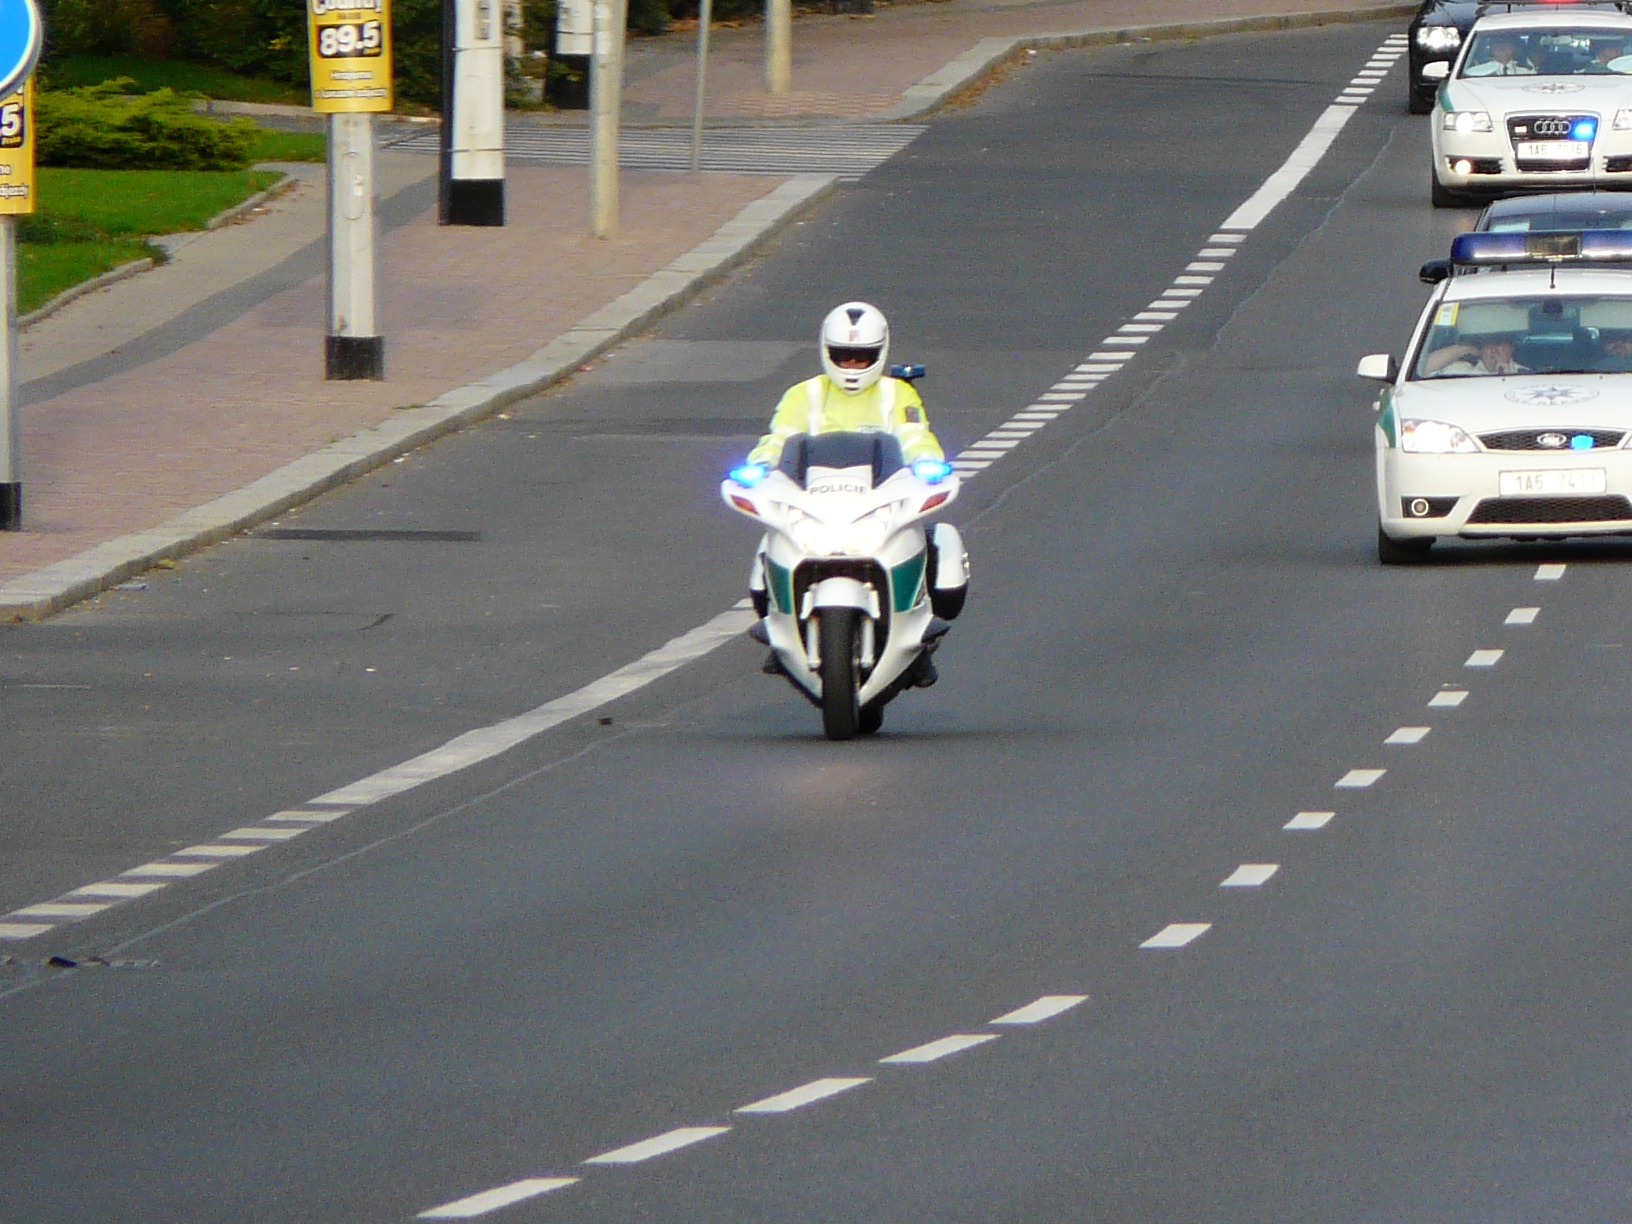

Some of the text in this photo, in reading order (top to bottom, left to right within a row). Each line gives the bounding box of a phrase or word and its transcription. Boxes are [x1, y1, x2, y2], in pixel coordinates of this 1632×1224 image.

[319, 19, 382, 56] 89.5
[1528, 143, 1547, 156] 1A5
[809, 483, 868, 495] POLICIE
[1515, 474, 1544, 491] 1A5
